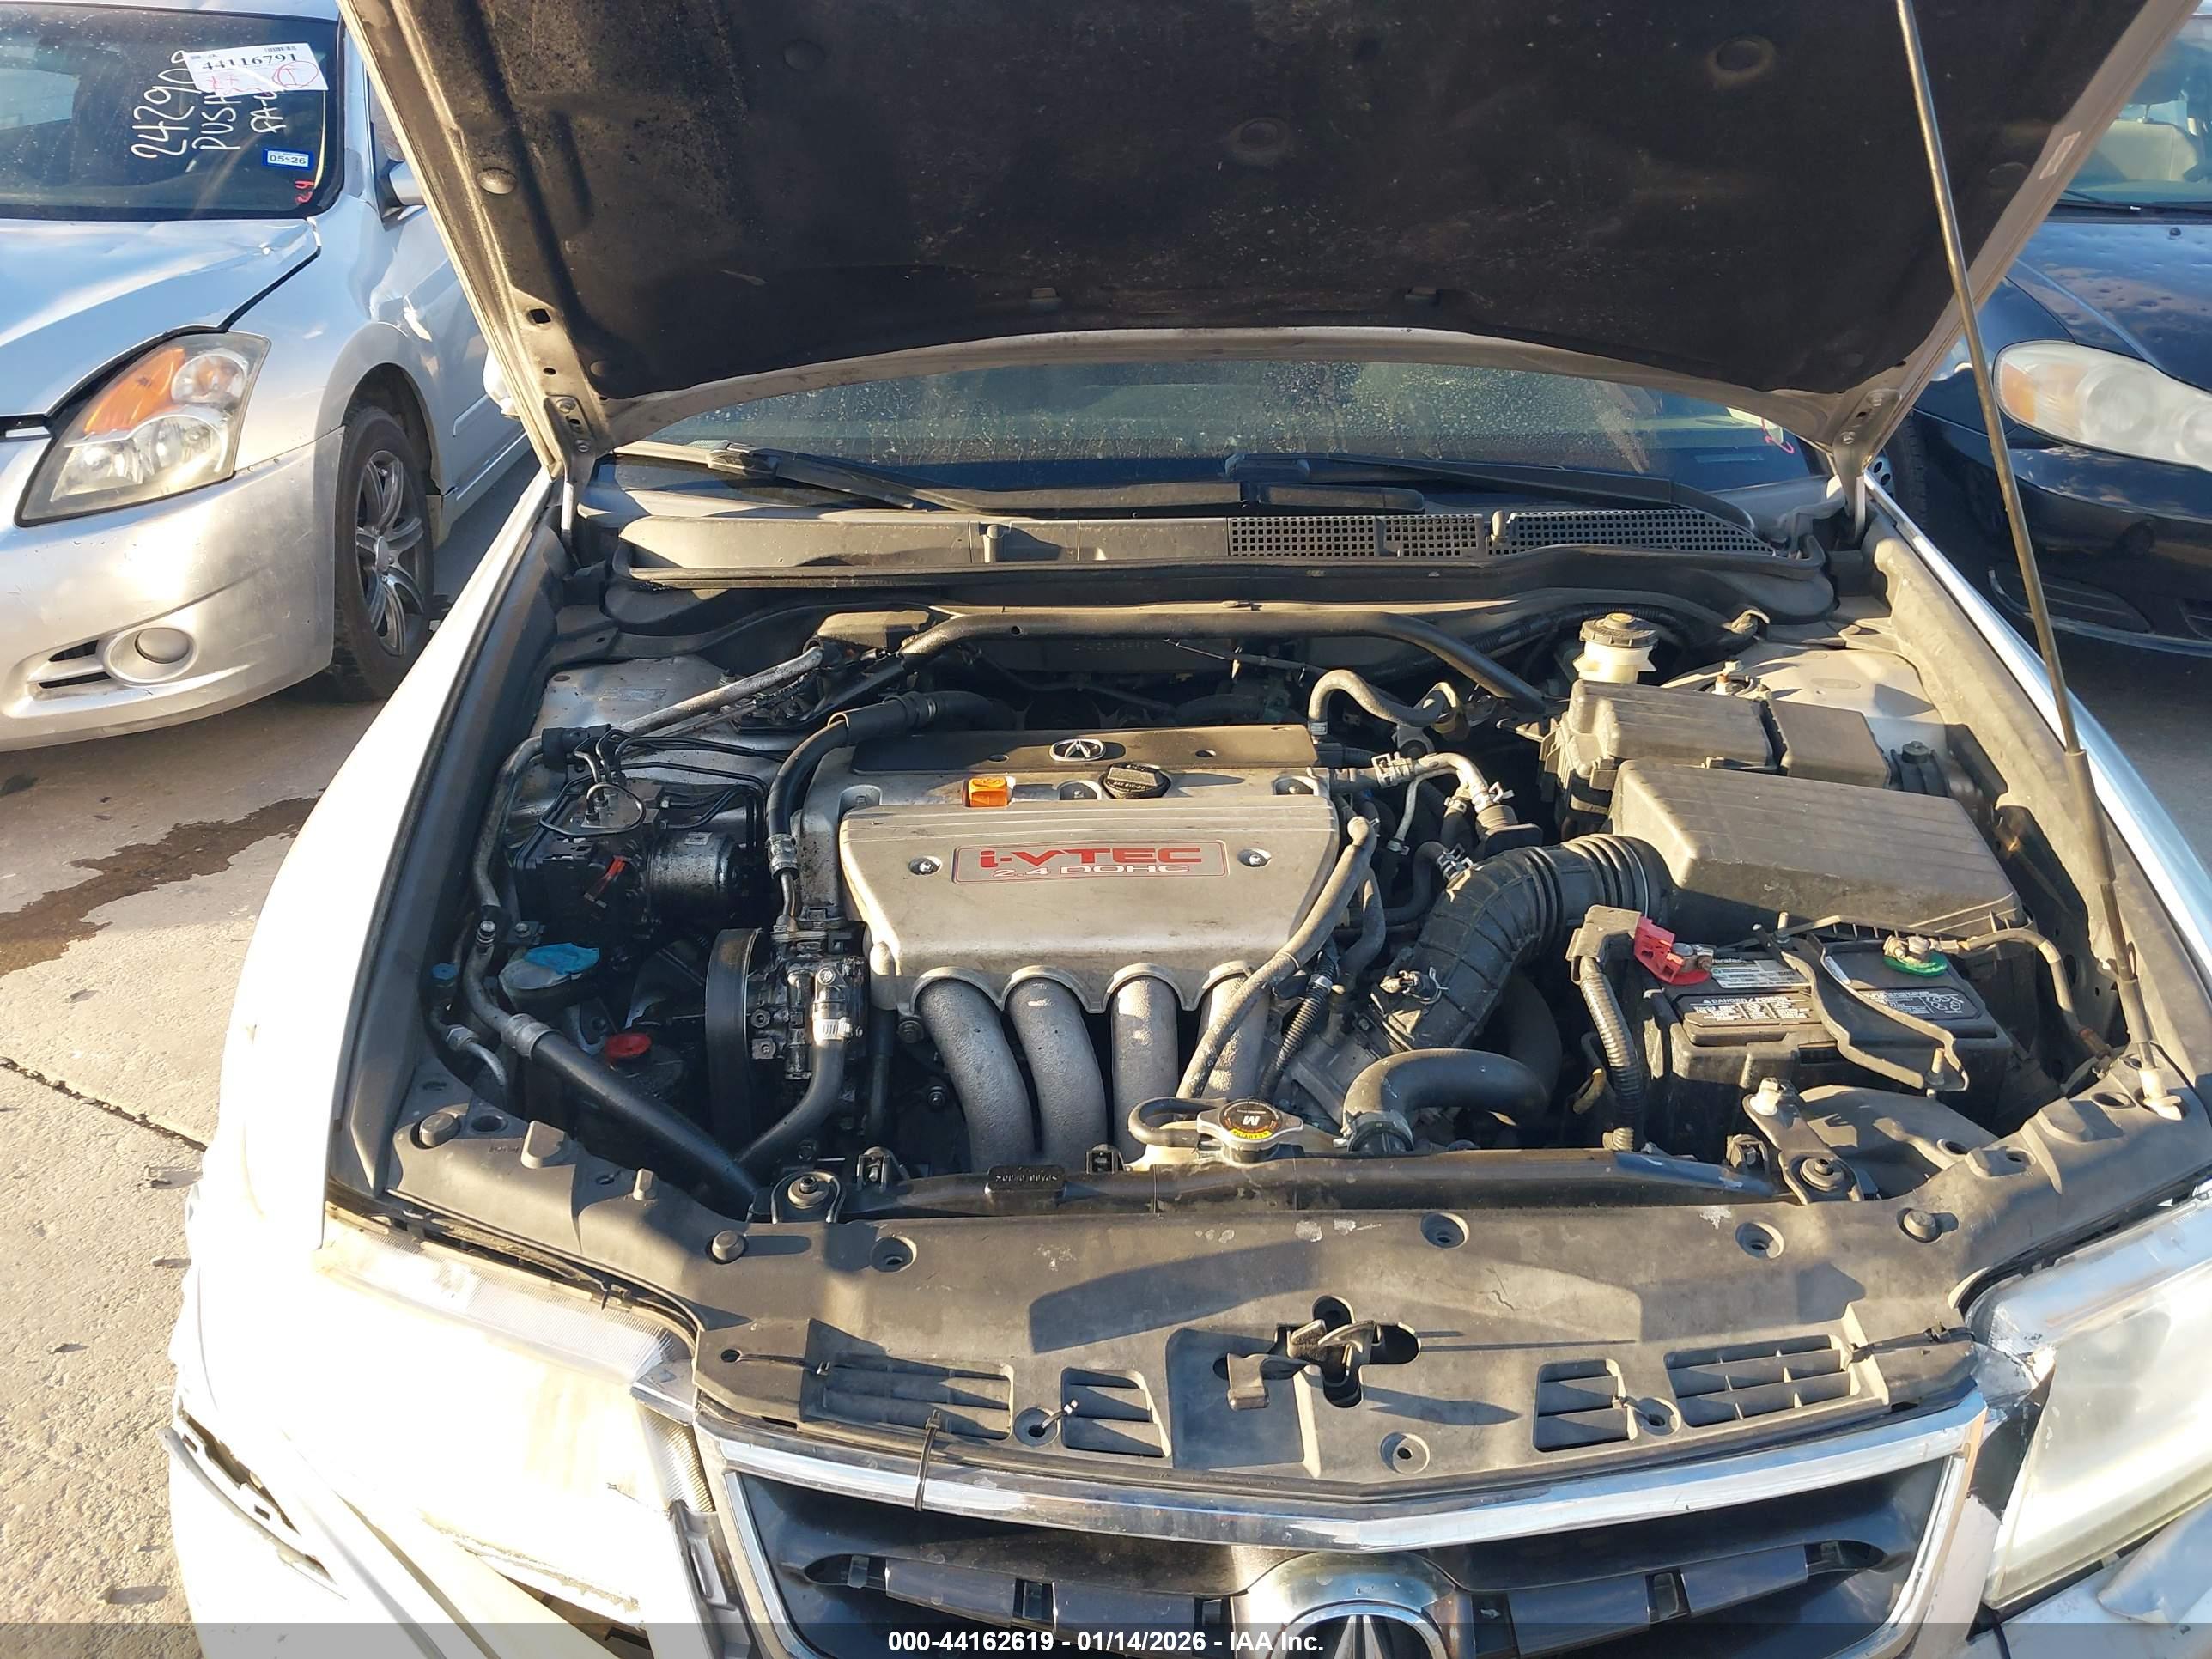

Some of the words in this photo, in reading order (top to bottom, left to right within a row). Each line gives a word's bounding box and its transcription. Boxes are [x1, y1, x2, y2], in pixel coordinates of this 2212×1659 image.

[202, 53, 296, 70] 44116791
[980, 848, 1202, 867] i-VTEC
[993, 867, 1051, 877] 2.4
[1060, 864, 1190, 874] DOHC
